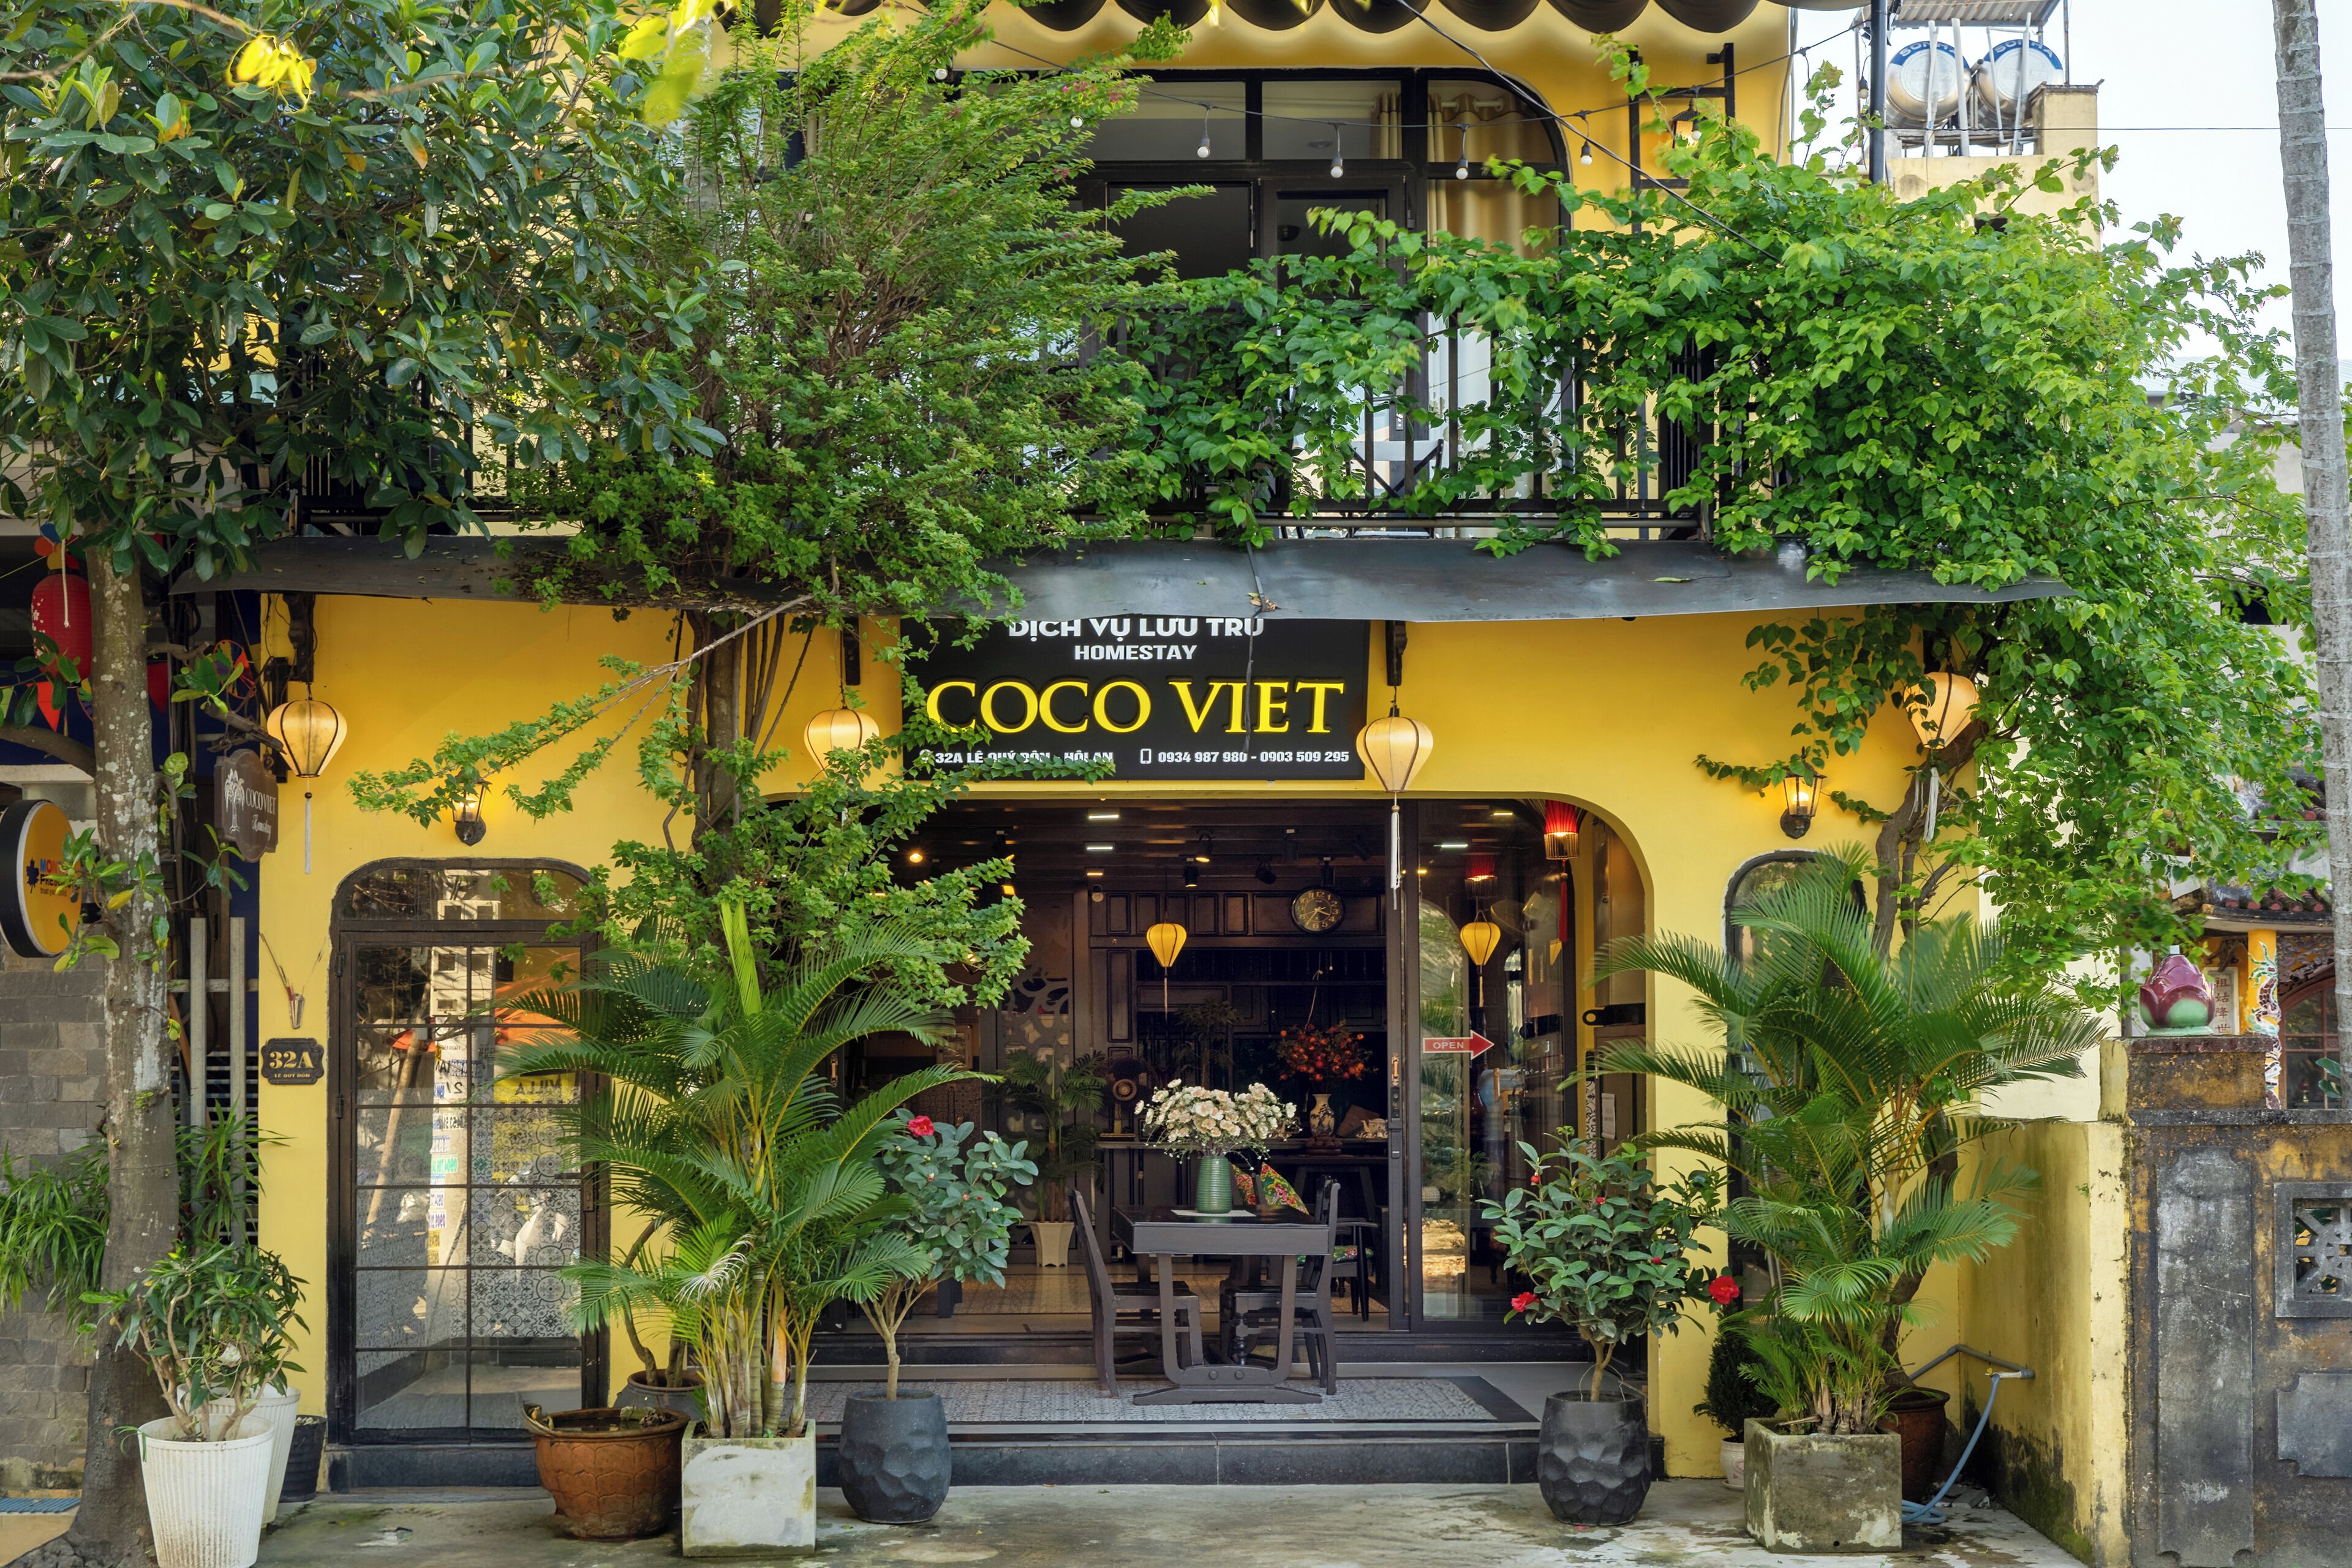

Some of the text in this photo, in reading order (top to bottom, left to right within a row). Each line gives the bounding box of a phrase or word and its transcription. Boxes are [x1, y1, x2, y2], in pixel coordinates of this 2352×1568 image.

[1089, 618, 1130, 642] VỤ
[1074, 645, 1197, 660] HOMESTAY
[926, 681, 1344, 733] COCO VIET
[935, 752, 963, 764] 32A
[967, 750, 984, 764] LÊ
[1158, 752, 1191, 763] 0934
[1194, 752, 1219, 763] 987
[1223, 752, 1248, 763] 980
[1260, 752, 1293, 763] 0903
[1296, 752, 1322, 763] 509
[1324, 752, 1349, 763] 295
[270, 1051, 315, 1069] 32A
